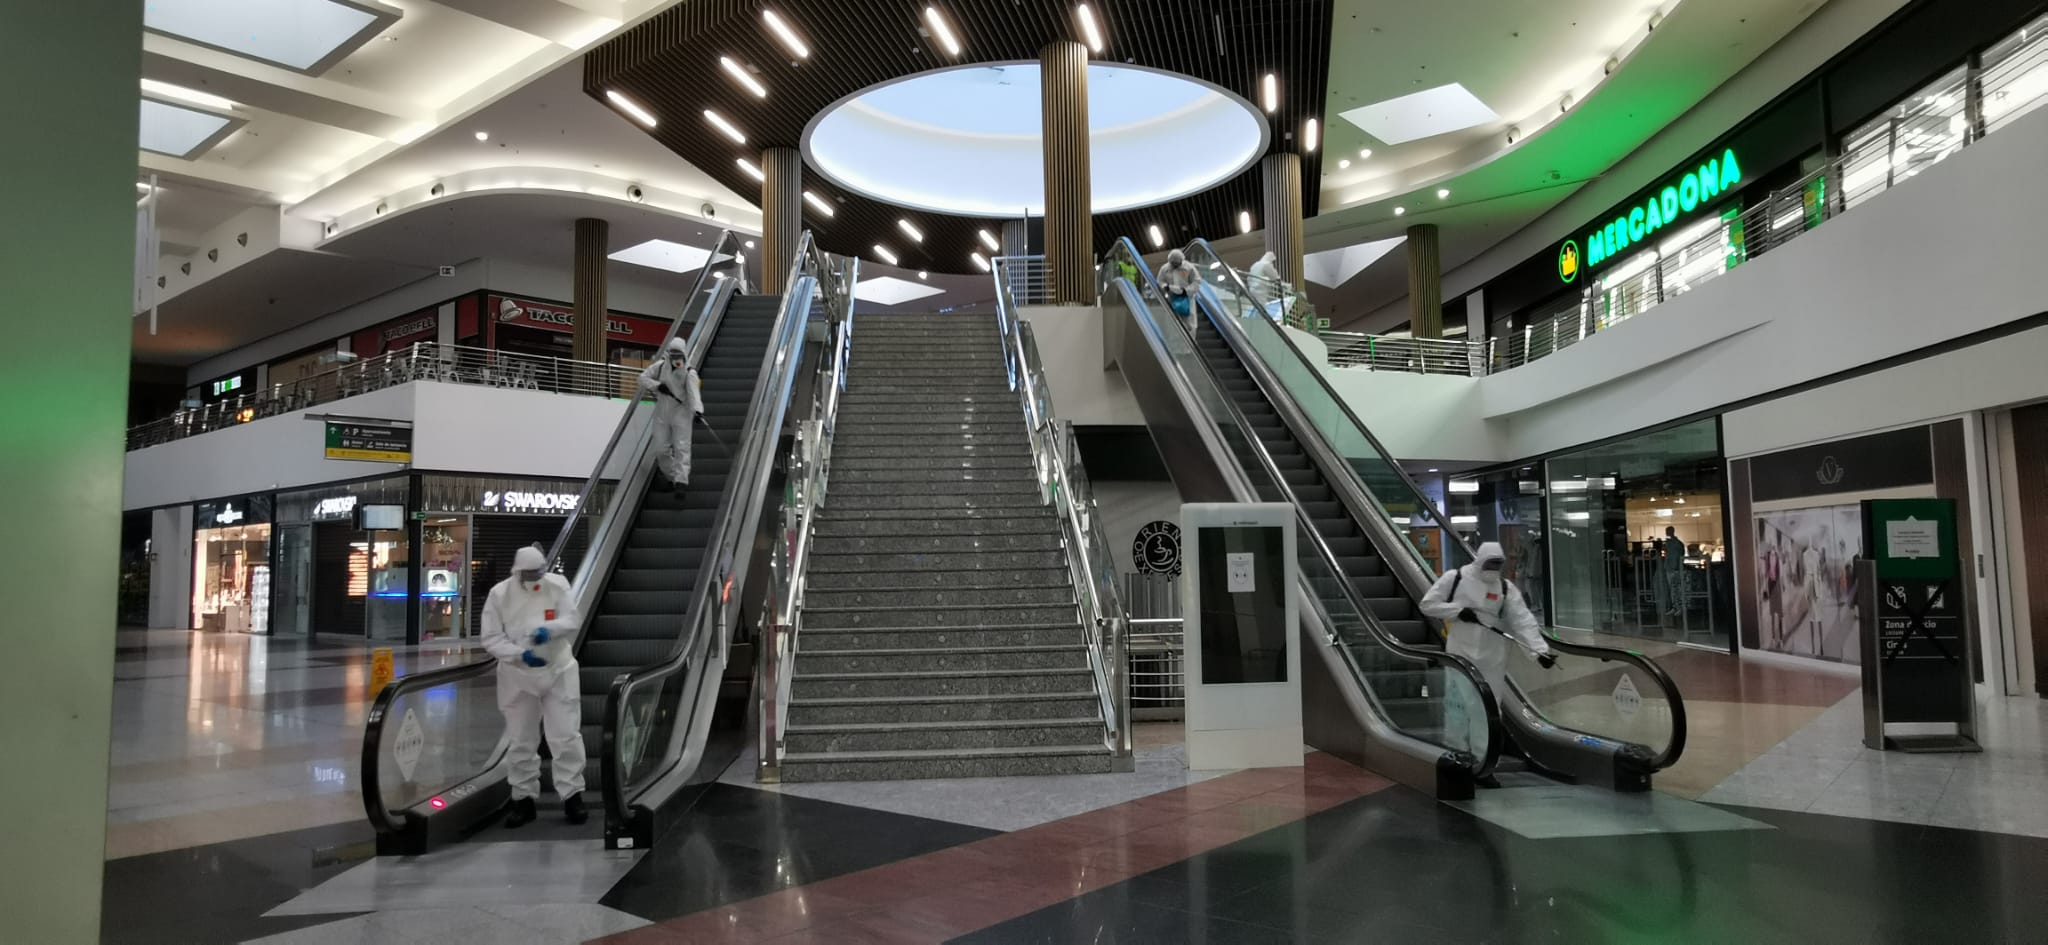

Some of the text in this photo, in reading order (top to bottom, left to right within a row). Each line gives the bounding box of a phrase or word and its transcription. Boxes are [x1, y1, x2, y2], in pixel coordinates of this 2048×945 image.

[1588, 148, 1741, 267] MERCADONA
[504, 490, 581, 510] SWAROVSK
[1885, 620, 1905, 629] Zona
[1922, 619, 1937, 629] cio
